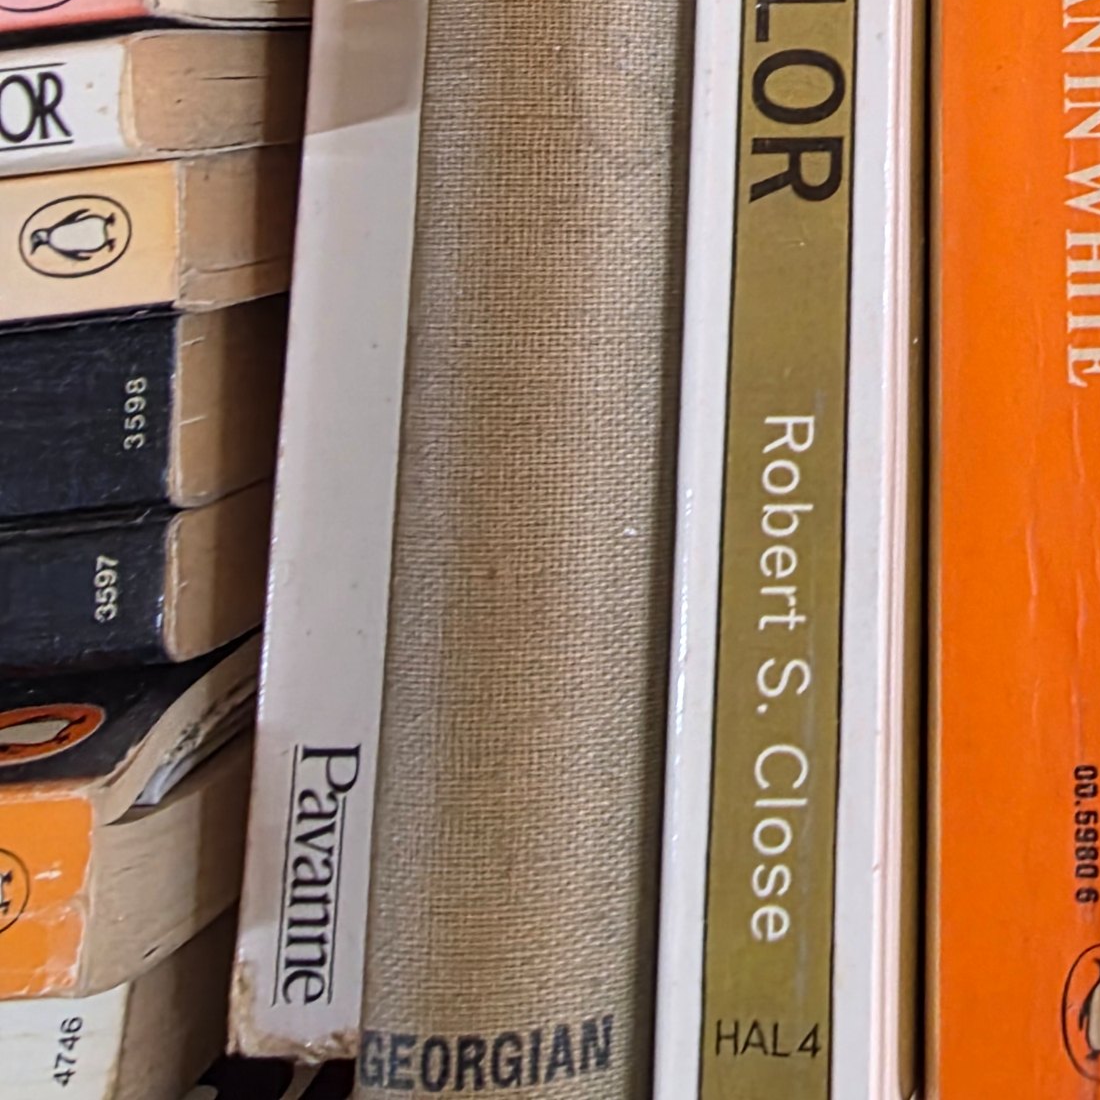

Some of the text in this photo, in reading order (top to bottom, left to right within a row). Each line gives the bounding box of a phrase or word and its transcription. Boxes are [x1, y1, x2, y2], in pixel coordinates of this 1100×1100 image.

[124, 376, 148, 449] 3598
[94, 555, 119, 622] 3597
[750, 414, 815, 943] Robert S. Close
[283, 743, 361, 1006] Pavanne
[1075, 887, 1099, 903] 6
[53, 1016, 84, 1087] 4746
[360, 1016, 614, 1093] GEORGIAN
[716, 1022, 822, 1059] HAL 4
